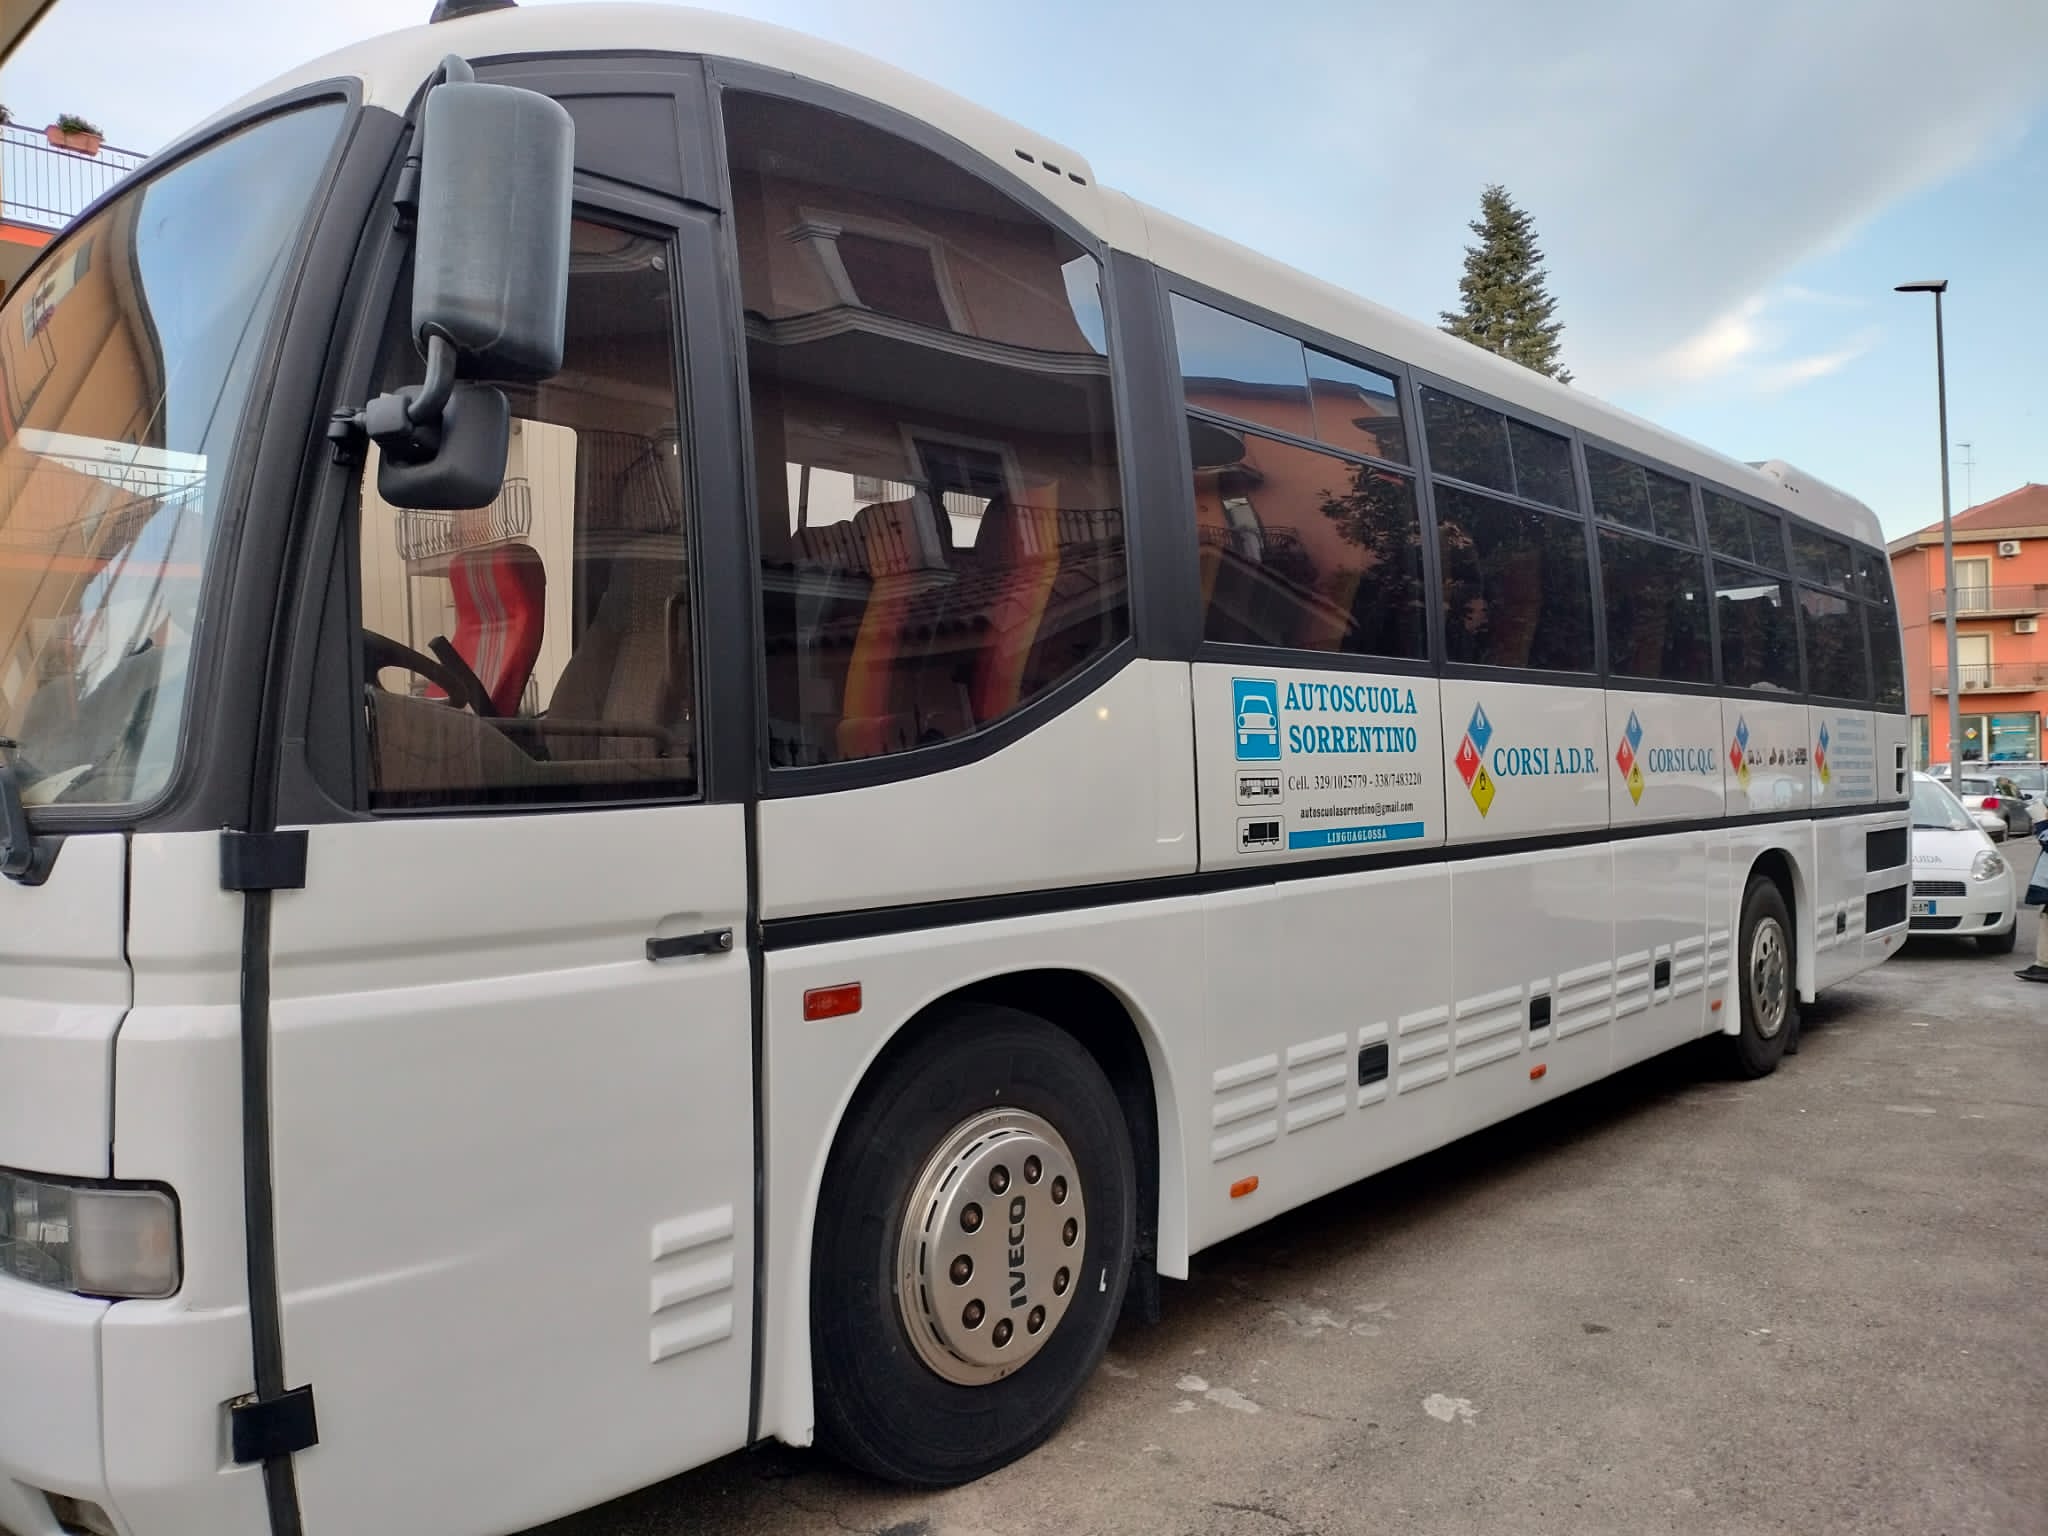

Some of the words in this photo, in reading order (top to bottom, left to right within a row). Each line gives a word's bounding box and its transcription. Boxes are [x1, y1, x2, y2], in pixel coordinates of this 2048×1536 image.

[1284, 682, 1418, 714] AUTOSCUOLA
[1289, 725, 1417, 754] SORRENTINO
[1493, 747, 1550, 776] CORSI
[1553, 747, 1599, 775] A.D.R.
[1648, 748, 1685, 773] CORSI
[1300, 800, 1414, 819] autoscuolasorrentino@gmail.com
[1327, 828, 1387, 843] LINGUAGLOSSA
[1008, 1195, 1027, 1309] IVECO
